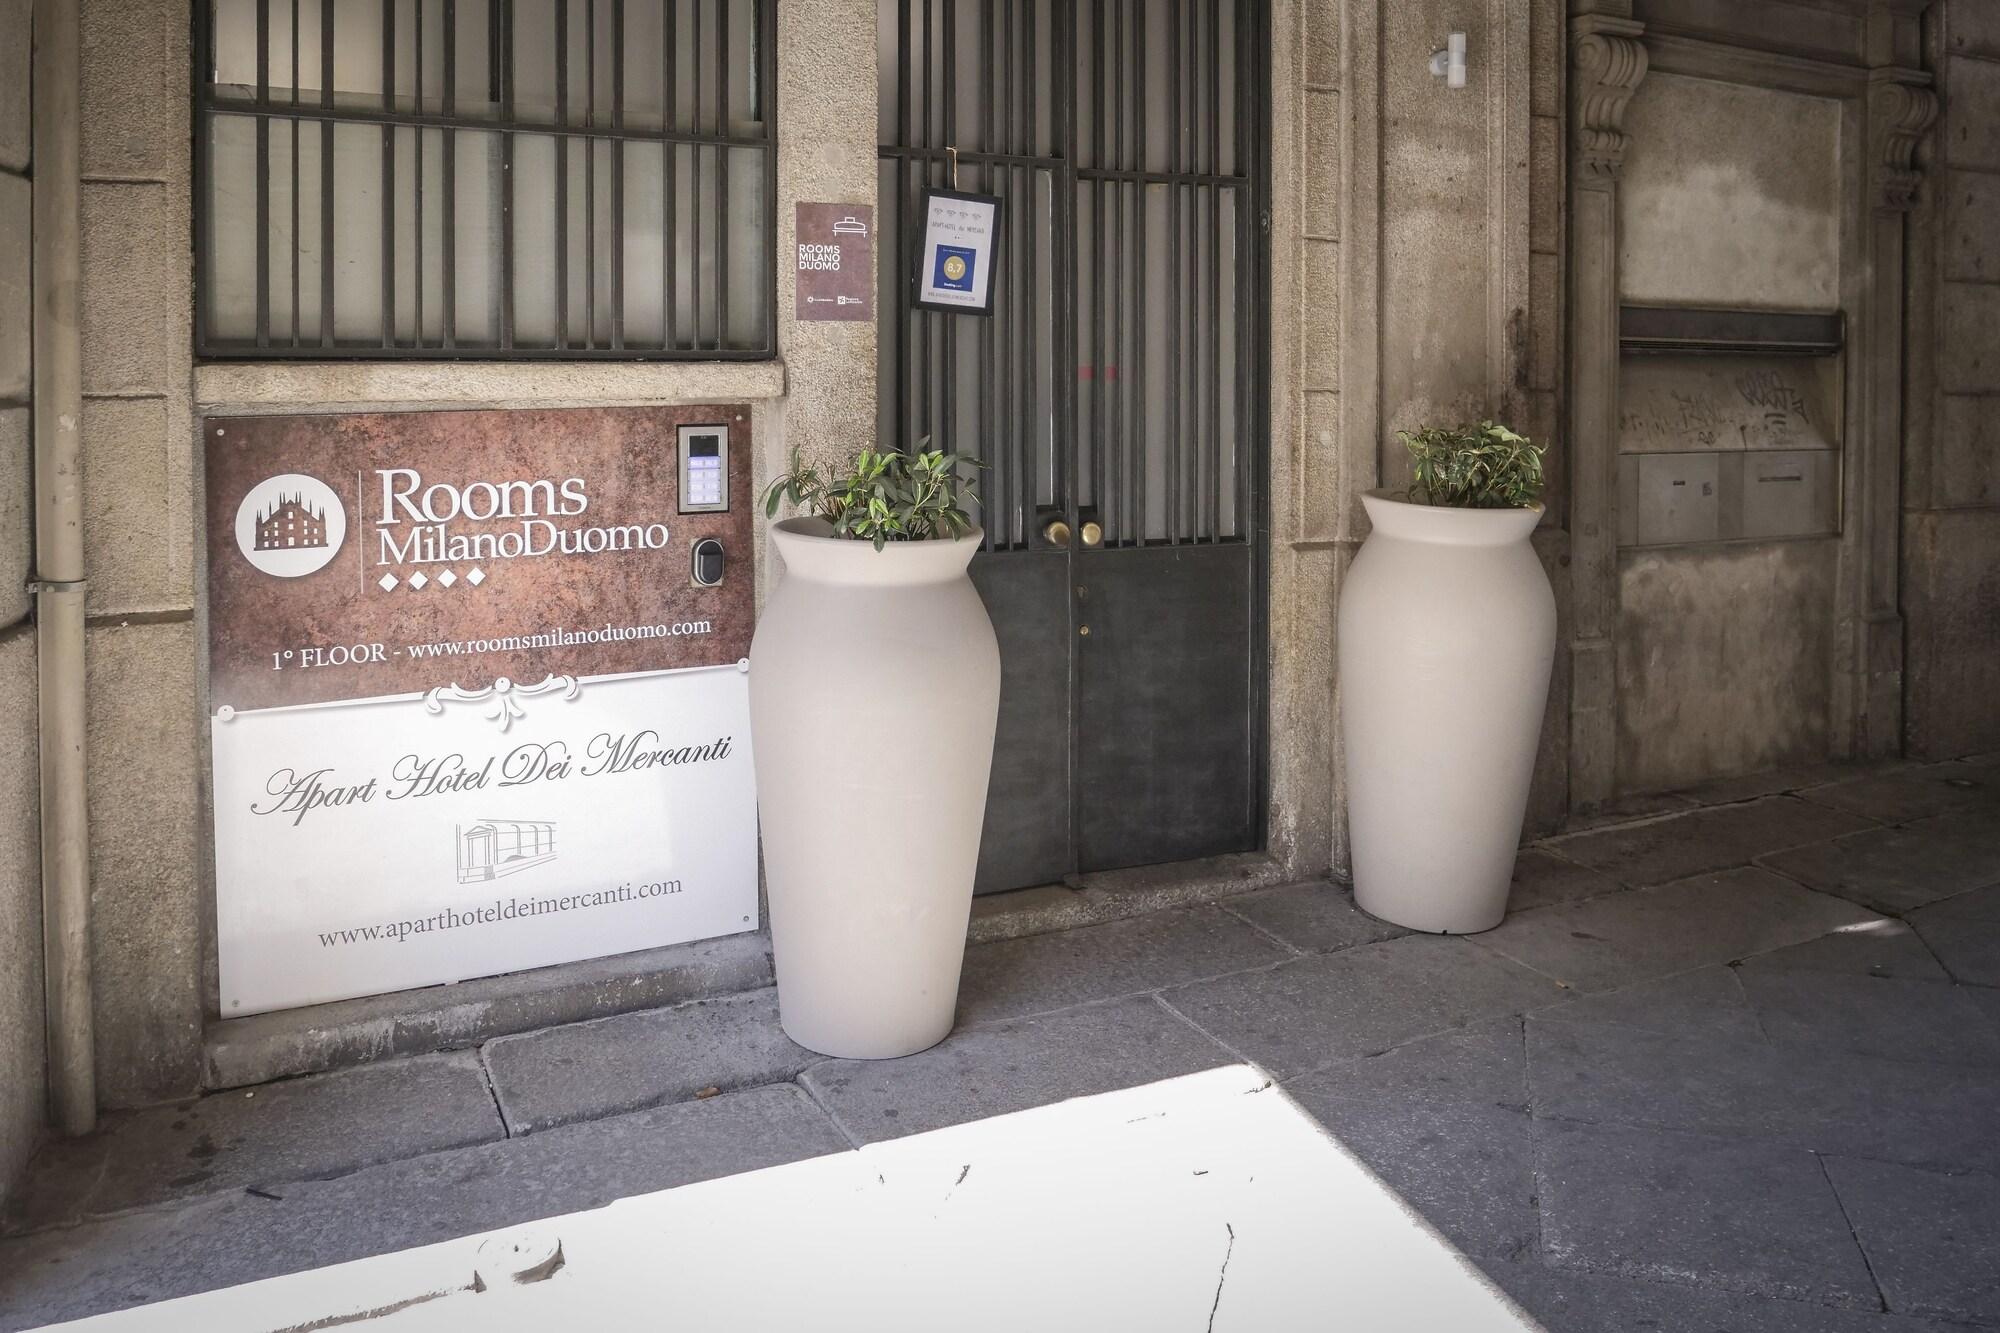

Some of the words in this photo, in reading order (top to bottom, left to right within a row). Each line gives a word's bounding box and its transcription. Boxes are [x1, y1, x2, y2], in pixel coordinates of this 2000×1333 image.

[799, 243, 841, 254] ROOMS
[799, 252, 841, 262] MILANO
[799, 261, 841, 271] DUOMO
[947, 262, 963, 273] 8.7
[376, 467, 588, 526] Rooms
[376, 519, 669, 565] MilanoDuomo
[272, 649, 293, 670] 1°
[300, 642, 387, 669] FLOOR
[408, 617, 711, 659] www.roomsmilanoduomo.com
[250, 768, 379, 827] Apart
[385, 753, 494, 801] Hotel
[498, 741, 573, 788] Dei
[580, 729, 733, 776] Mercanti
[318, 877, 683, 949] www.aparthoteldeimercanti.com
